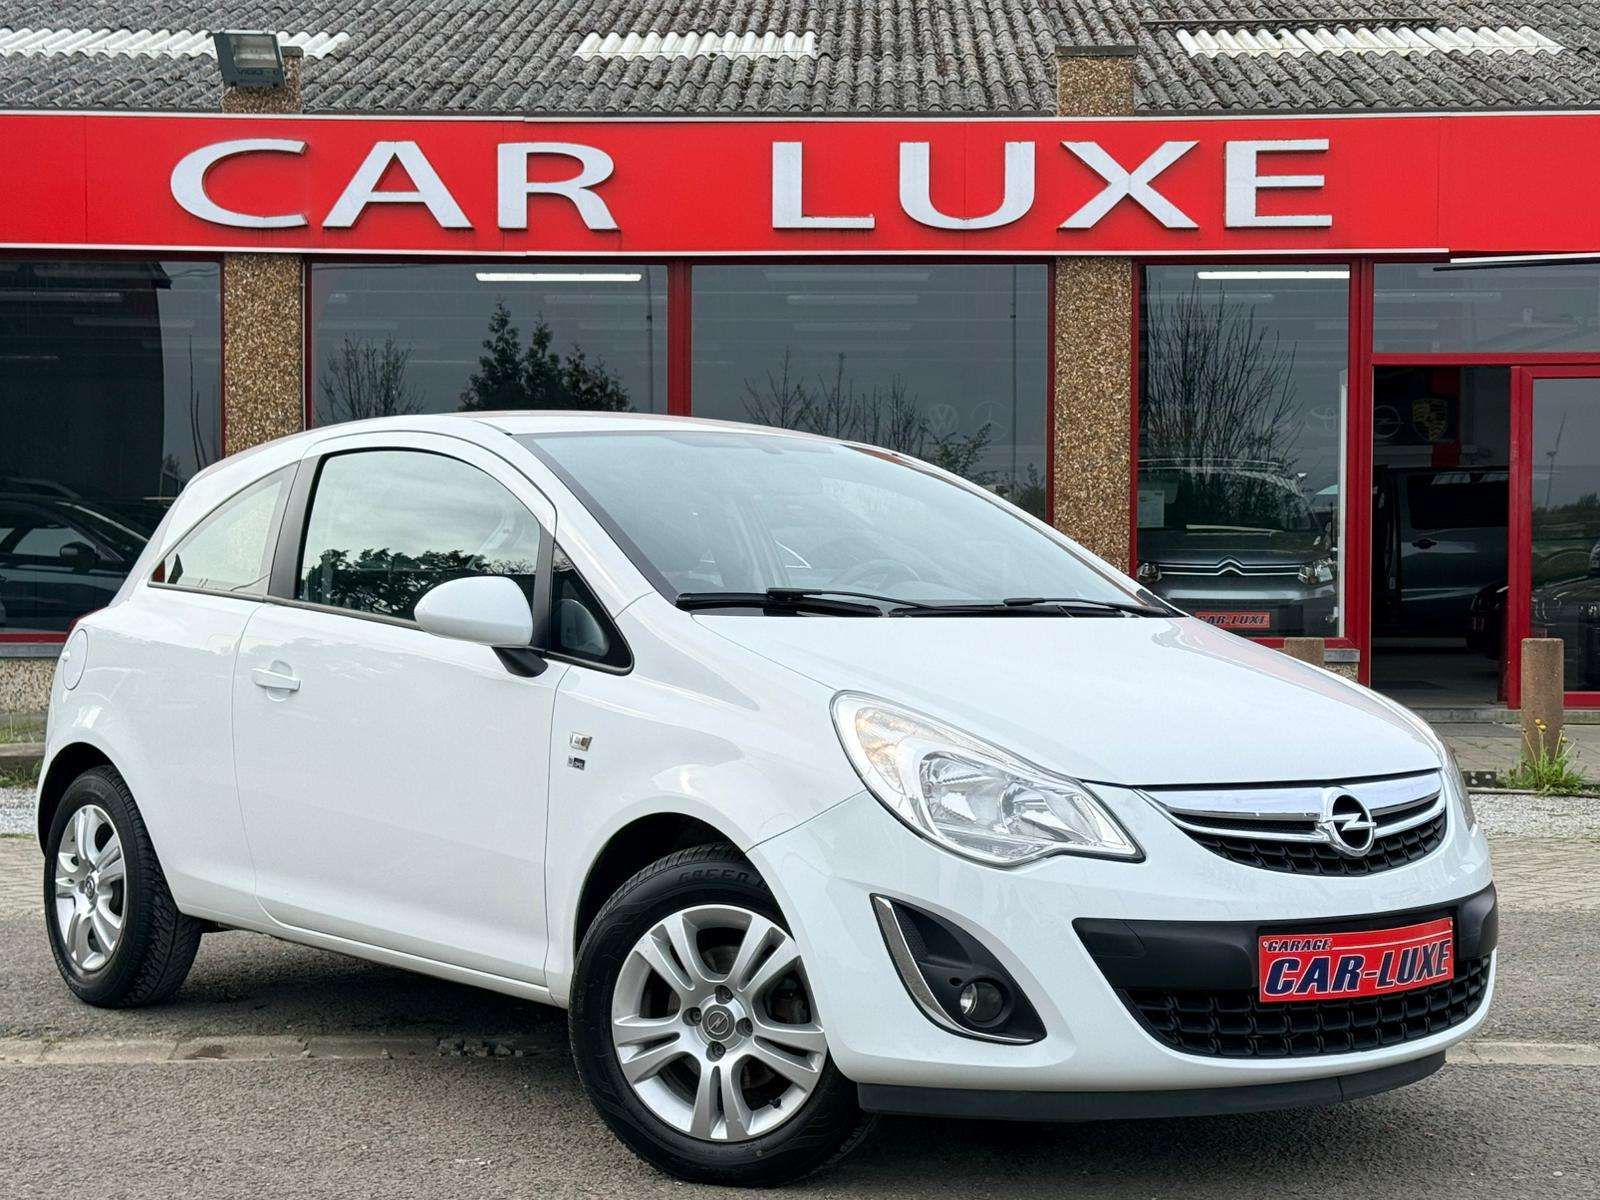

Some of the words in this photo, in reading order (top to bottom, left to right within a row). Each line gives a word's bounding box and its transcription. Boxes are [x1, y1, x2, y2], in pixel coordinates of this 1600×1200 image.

[170, 138, 619, 230] CAR
[771, 138, 1334, 230] LUXE
[1264, 938, 1450, 997] CAR-LUXE
[1267, 937, 1334, 953] GARAGE
